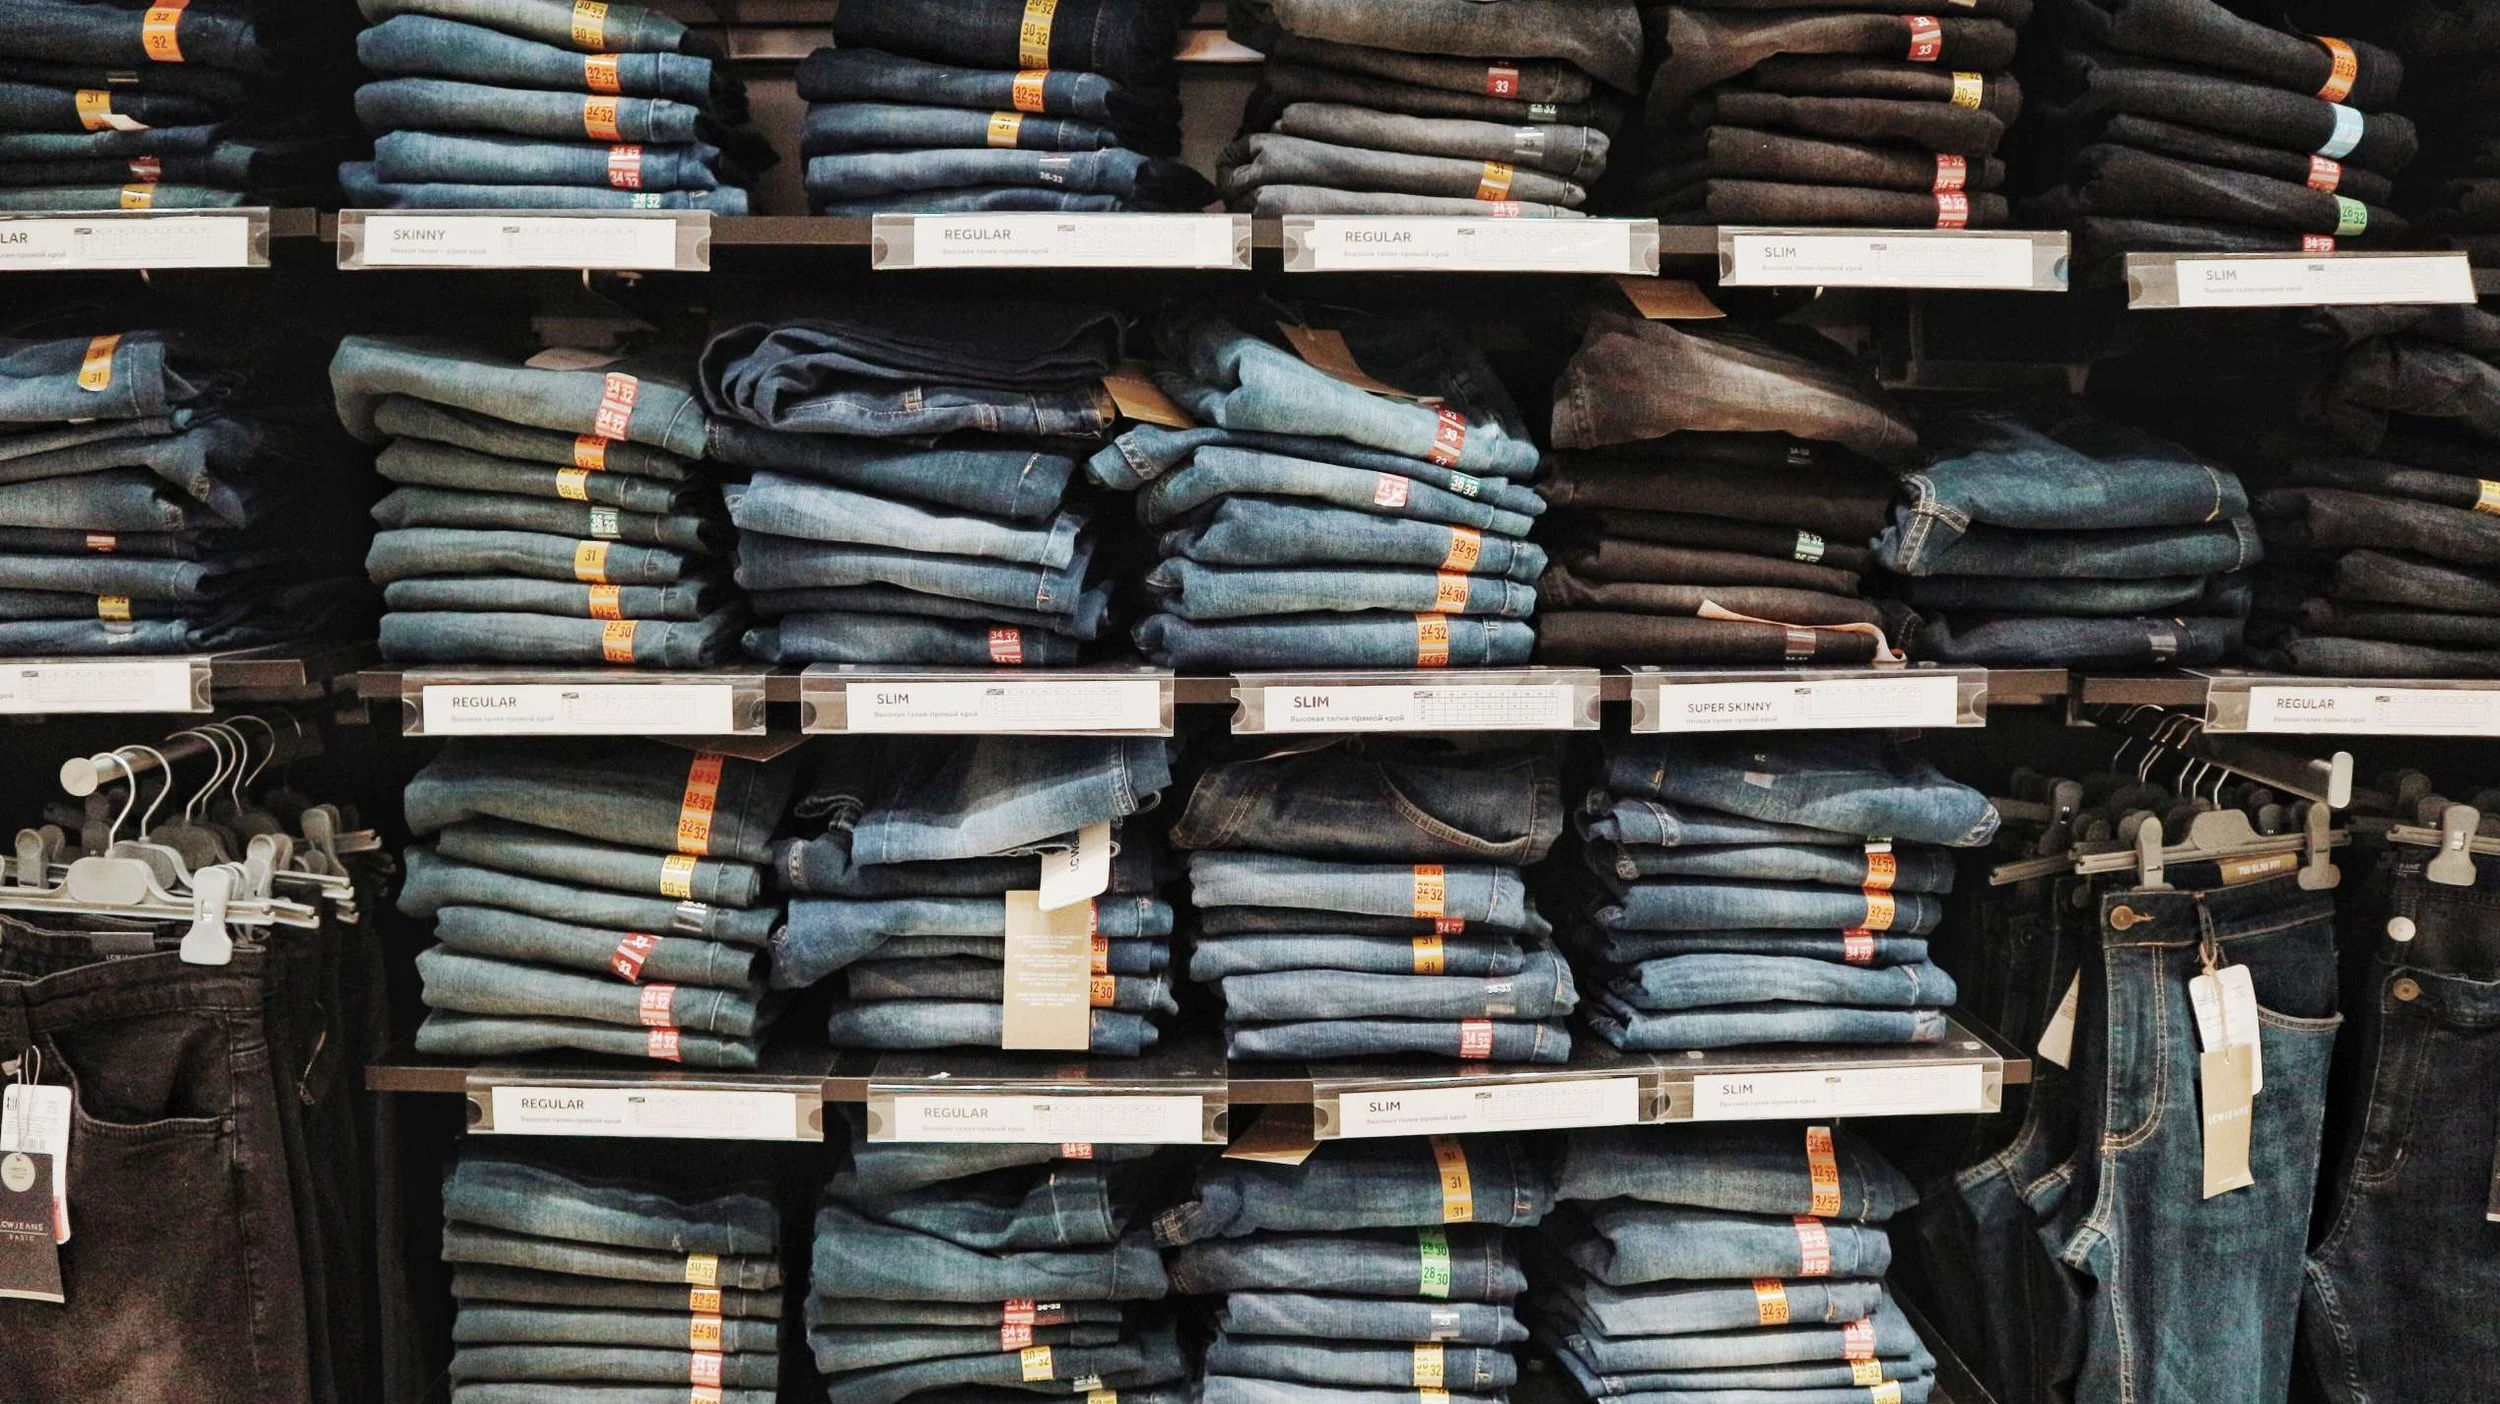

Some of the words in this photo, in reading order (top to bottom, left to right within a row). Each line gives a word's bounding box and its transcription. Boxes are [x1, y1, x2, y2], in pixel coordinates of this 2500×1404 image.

[591, 7, 605, 19] 32
[1041, 3, 1053, 16] 32
[154, 12, 169, 21] 32
[574, 27, 587, 40] 30
[1023, 23, 1035, 36] 30
[1035, 31, 1047, 46] 32
[152, 36, 167, 49] 32
[1918, 44, 1932, 55] 33
[1021, 53, 1033, 65] 30
[587, 66, 601, 80] 32
[603, 73, 616, 85] 32
[1495, 80, 1509, 93] 33
[87, 93, 100, 104] 31
[1015, 86, 1027, 100] 32
[1028, 92, 1041, 105] 32
[1955, 88, 1968, 100] 30
[601, 109, 614, 123] 32
[610, 170, 625, 183] 34
[2342, 205, 2353, 217] 28
[2354, 212, 2366, 225] 32
[394, 229, 446, 241] SKINNY
[945, 229, 1011, 240] REGULAR
[1345, 231, 1411, 242] REGULAR
[1765, 247, 1796, 258] SLIM
[2206, 270, 2237, 281] SLIM
[90, 373, 102, 382] 31
[608, 378, 620, 393] 34
[620, 387, 633, 402] 32
[600, 408, 612, 424] 34
[612, 418, 625, 434] 32
[560, 485, 571, 496] 30
[1463, 483, 1478, 497] 32
[604, 520, 617, 533] 32
[585, 549, 596, 561] 31
[1453, 538, 1465, 552] 32
[1465, 547, 1477, 561] 32
[1441, 583, 1453, 596] 32
[1453, 589, 1466, 602] 30
[606, 621, 619, 631] 32
[619, 626, 631, 638] 30
[991, 630, 1003, 639] 34
[1007, 632, 1018, 640] 32
[1421, 624, 1433, 635] 32
[1434, 627, 1447, 640] 32
[452, 697, 517, 708] REGULAR
[876, 694, 909, 705] SLIM
[1294, 696, 1329, 708] SLIM
[2277, 698, 2335, 709] REGULAR
[1687, 703, 1725, 713] SUPER
[1728, 702, 1772, 712] SKINNY
[1290, 715, 1324, 723] Высокая
[1385, 714, 1405, 723] крой
[685, 791, 699, 805] 32
[699, 797, 713, 811] 32
[680, 819, 694, 833] 32
[694, 825, 707, 840] 32
[667, 856, 680, 865] 30
[1070, 858, 1080, 872] LC
[1870, 855, 1881, 867] 32
[1882, 860, 1894, 873] 32
[662, 882, 674, 893] 30
[1417, 883, 1429, 895] 32
[1430, 887, 1443, 901] 32
[1870, 905, 1880, 917] 32
[1880, 912, 1892, 924] 32
[1436, 922, 1449, 934] 34
[1093, 940, 1106, 952] 30
[1424, 961, 1435, 971] 31
[1100, 987, 1113, 999] 30
[1722, 1084, 1753, 1095] SLIM
[521, 1098, 584, 1110] REGULAR
[1369, 1101, 1400, 1112] SLIM
[925, 1107, 988, 1118] REGULAR
[1808, 1134, 1819, 1147] 32
[1820, 1139, 1832, 1152] 32
[1062, 1143, 1076, 1154] 34
[1077, 1146, 1090, 1156] 32
[1812, 1164, 1824, 1177] 32
[1824, 1169, 1837, 1182] 32
[1451, 1176, 1462, 1189] 31
[1815, 1195, 1827, 1207] 32
[1827, 1199, 1839, 1212] 32
[1453, 1206, 1464, 1217] 31
[1435, 1244, 1447, 1256] 30
[689, 1262, 701, 1272] 30
[702, 1267, 714, 1279] 32
[1423, 1266, 1435, 1279] 28
[1435, 1273, 1448, 1286] 30
[693, 1292, 705, 1304] 32
[705, 1299, 718, 1309] 32
[1762, 1303, 1774, 1316] 32
[1775, 1307, 1787, 1319] 32
[706, 1326, 718, 1340] 30
[1023, 1350, 1036, 1361] 30
[1429, 1365, 1442, 1377] 32
[1868, 1365, 1880, 1378] 32
